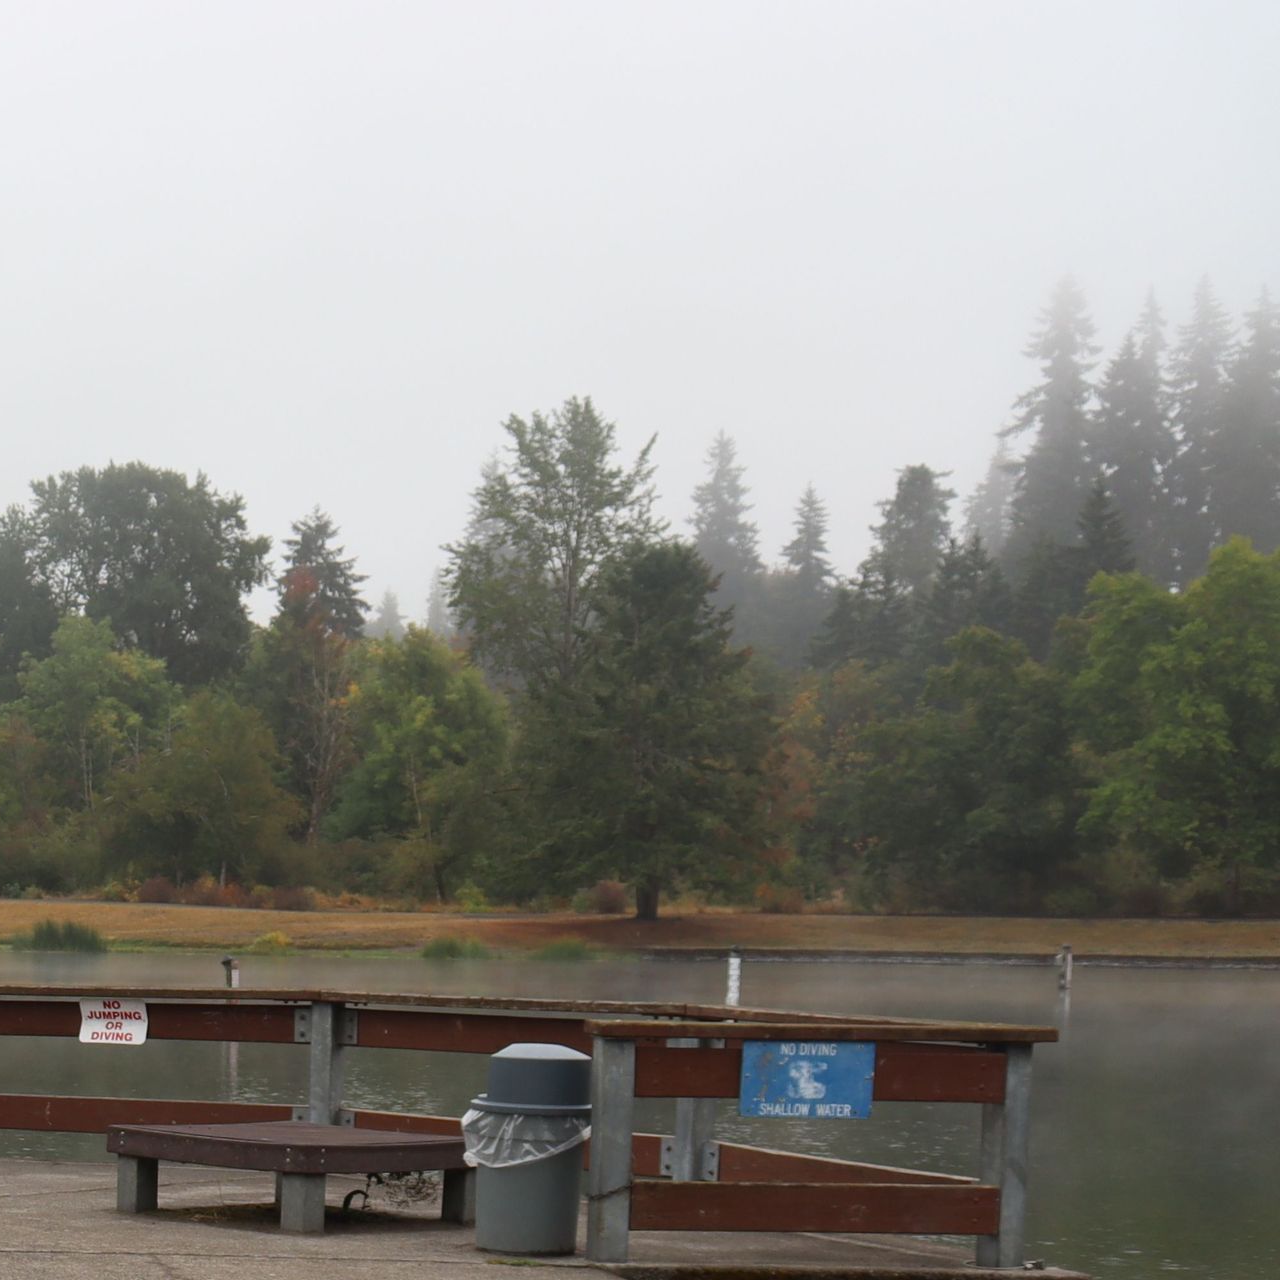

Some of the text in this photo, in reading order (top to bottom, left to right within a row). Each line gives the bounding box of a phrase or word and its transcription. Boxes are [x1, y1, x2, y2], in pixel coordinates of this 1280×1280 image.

[103, 1001, 121, 1010] NO
[87, 1011, 142, 1020] JUMPING
[105, 1021, 123, 1030] OR
[91, 1032, 133, 1041] DIVING
[781, 1043, 837, 1056] NO DIVING
[760, 1103, 852, 1117] SHALLOW WATER
